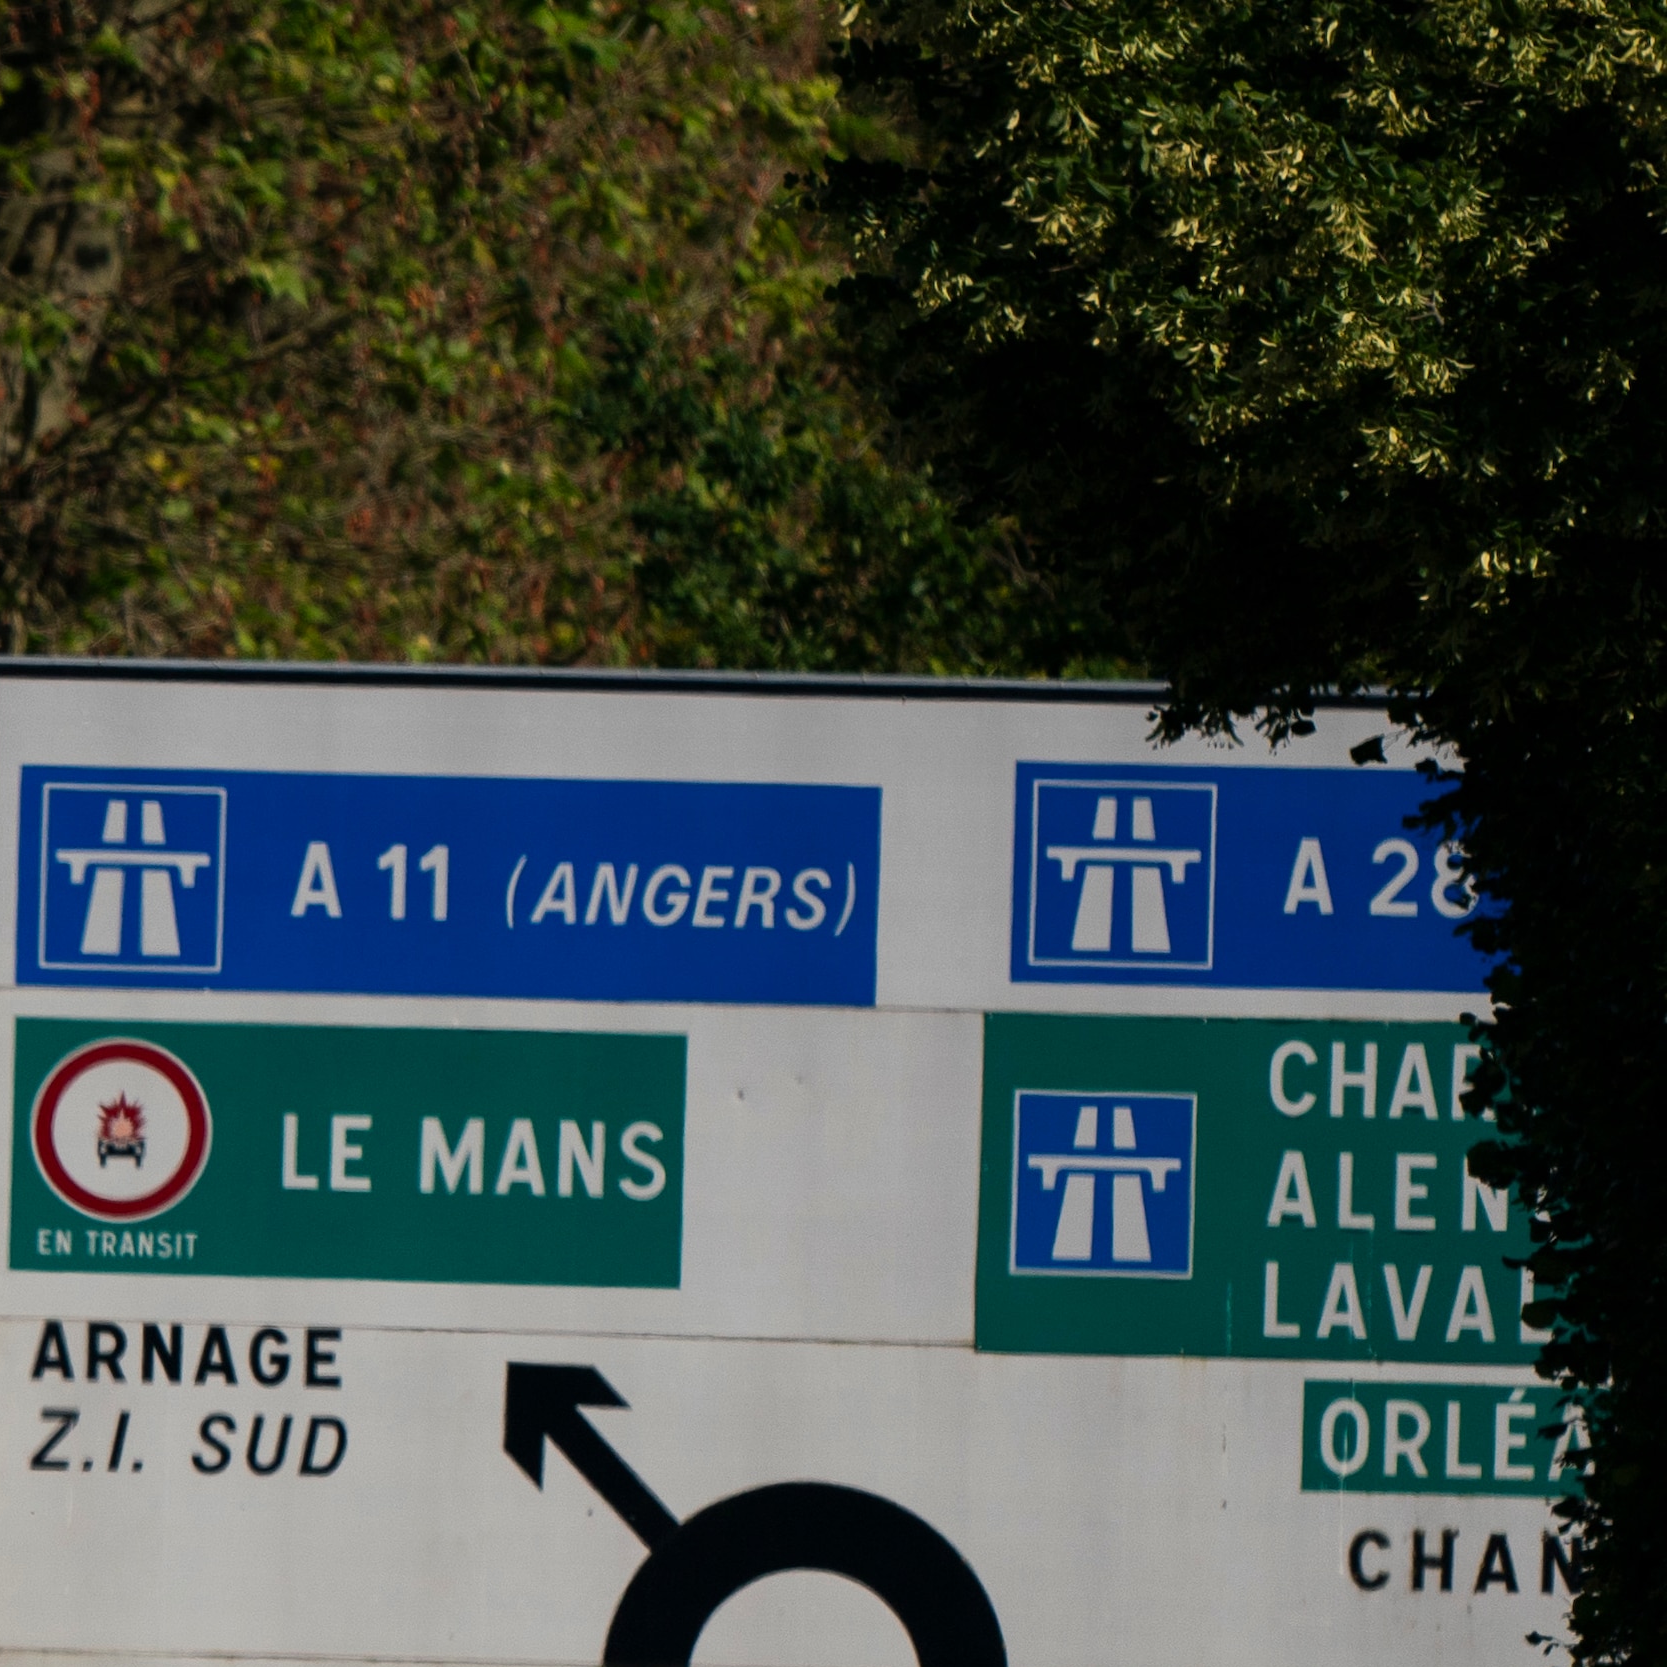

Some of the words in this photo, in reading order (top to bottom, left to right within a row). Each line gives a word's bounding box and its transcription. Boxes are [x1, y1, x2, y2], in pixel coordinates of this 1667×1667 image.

[292, 841, 342, 919] A
[377, 844, 450, 922] 11
[505, 855, 858, 938] (ANGERS)
[1283, 838, 1334, 916] A
[1369, 838, 1481, 919] 28
[281, 1113, 373, 1193] LE
[418, 1115, 667, 1201] MANS
[1266, 1150, 1551, 1233] ALEN
[37, 1229, 73, 1257] EN
[86, 1230, 199, 1261] TRANSIT
[1262, 1260, 1555, 1344] LAVAL
[31, 1319, 344, 1388] ARNAGE
[29, 1408, 145, 1473] Z.I.
[190, 1412, 350, 1478] SUD
